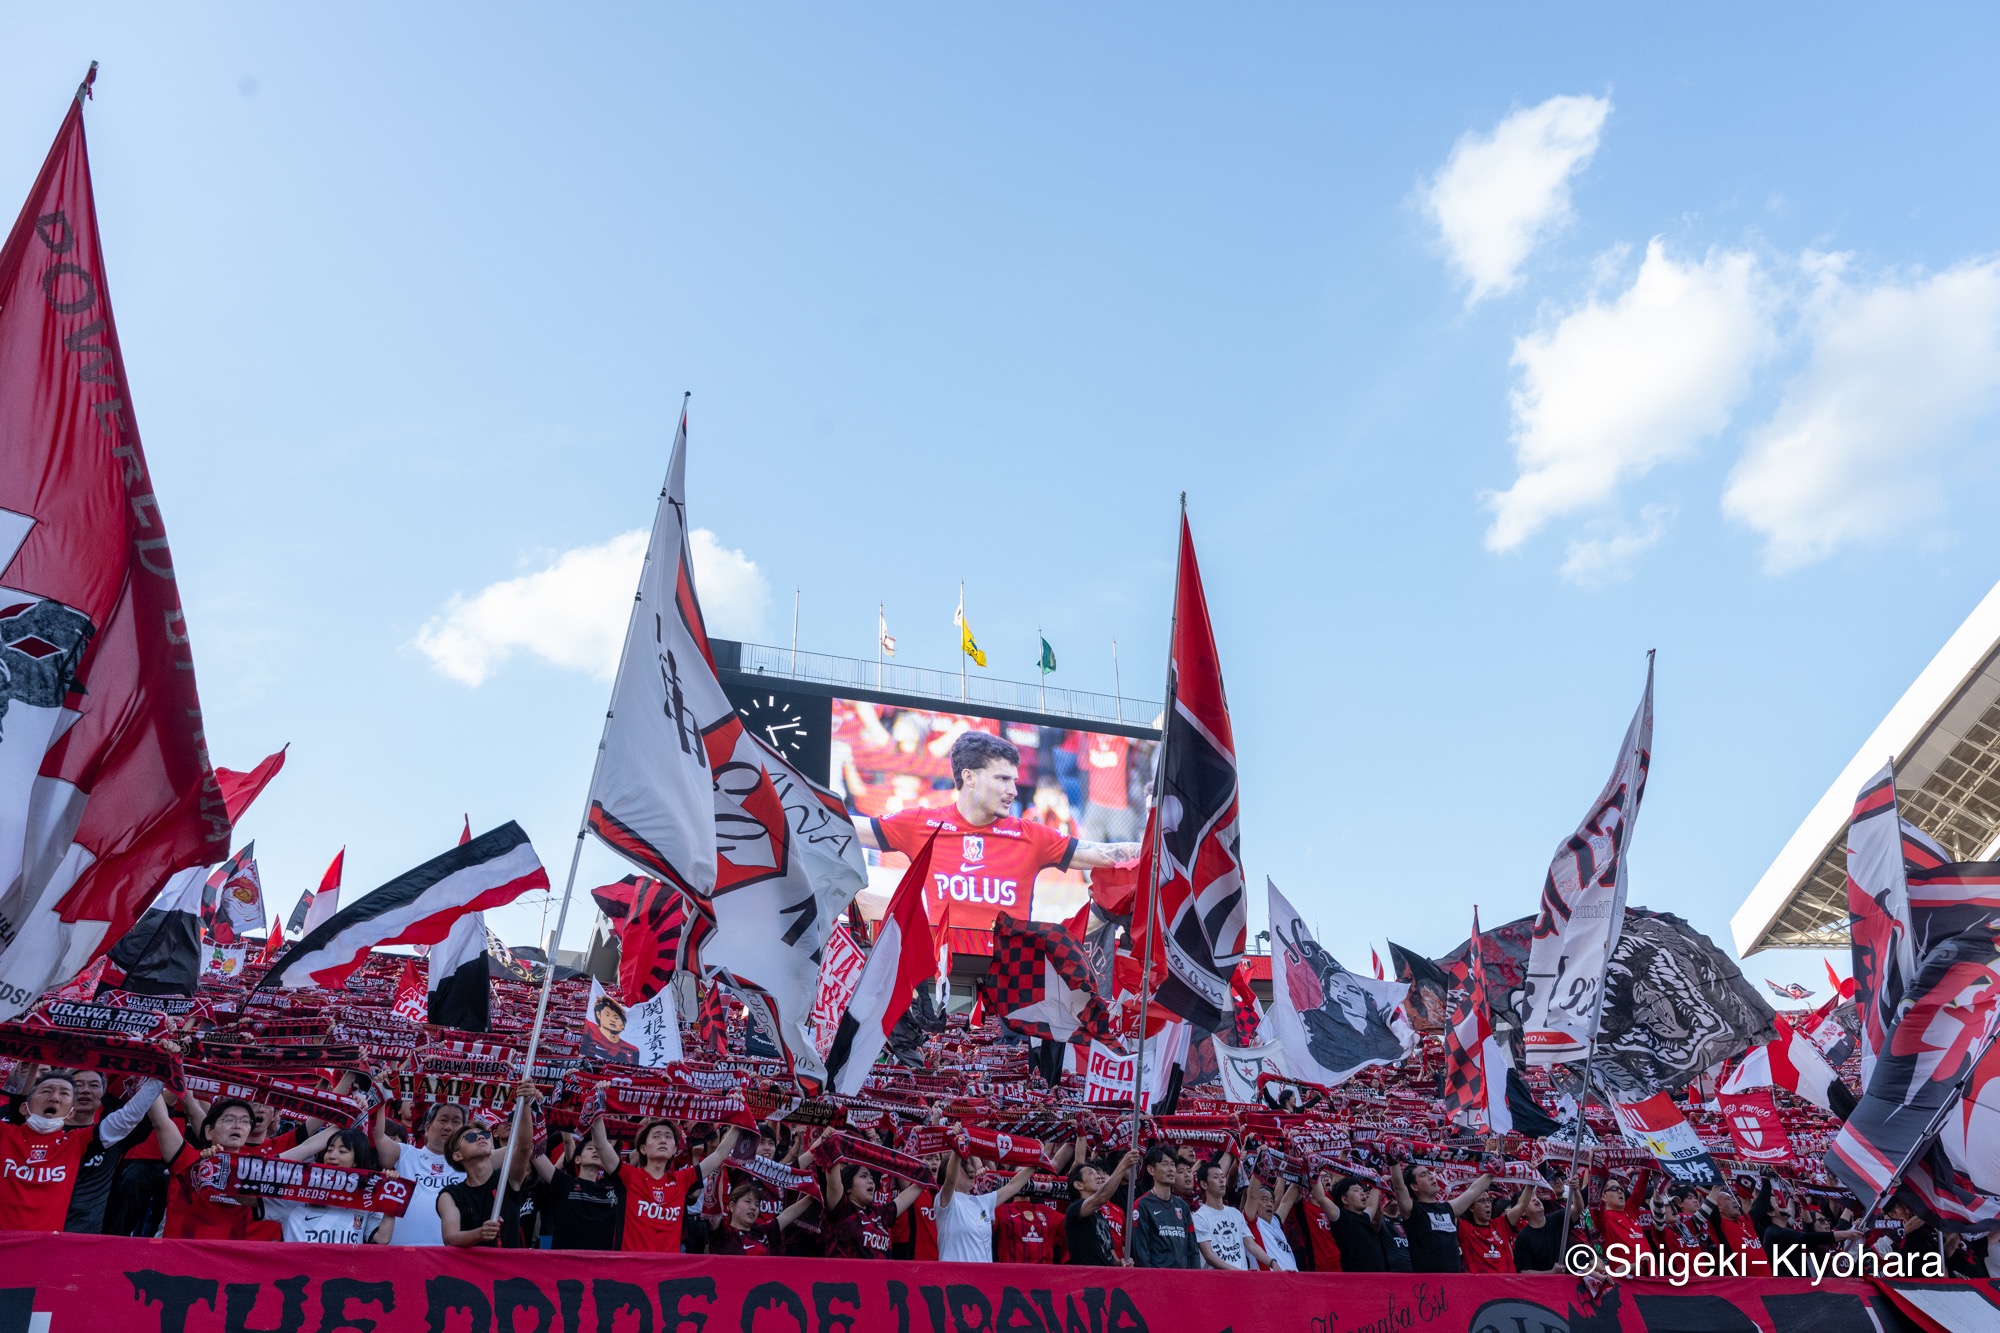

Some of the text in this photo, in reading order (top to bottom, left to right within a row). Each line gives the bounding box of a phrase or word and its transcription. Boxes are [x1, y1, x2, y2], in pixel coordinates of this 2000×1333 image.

[933, 873, 1017, 907] POLUS
[126, 994, 195, 1010] URAWA REDS
[48, 1001, 164, 1029] URAWA REDS
[51, 1014, 151, 1036] PRIDE OF URAWA
[333, 1023, 418, 1041] Here We Go!
[380, 1038, 416, 1048] REDS
[563, 1032, 582, 1043] URAW
[426, 1060, 508, 1074] URAWA REDS
[757, 1063, 783, 1077] RED
[1091, 1051, 1135, 1082] RED
[184, 1075, 255, 1099] RIDE OF
[384, 1074, 517, 1104] CHAMPION
[1005, 1086, 1025, 1100] LIFE
[269, 1092, 349, 1127] URAWA
[797, 1099, 834, 1117] REDS
[1233, 1104, 1264, 1112] URAWA
[1474, 1112, 1484, 1123] A
[1165, 1128, 1226, 1144] CHAMPIONS
[1293, 1133, 1312, 1143] ere
[1311, 1130, 1330, 1142] We
[999, 1140, 1010, 1150] 12
[1322, 1139, 1352, 1150] REDS
[1671, 1146, 1700, 1159] REDS
[236, 1156, 360, 1193] URAWA REDS
[1445, 1162, 1477, 1173] DIAMONDS
[415, 1173, 459, 1189] POLUS
[259, 1183, 330, 1200] We are REDS!
[362, 1173, 382, 1208] URAWA
[379, 1181, 408, 1204] 13
[637, 1199, 682, 1222] POLUS
[759, 1199, 785, 1215] OLUS
[862, 1231, 891, 1251] POLUS
[1158, 1229, 1186, 1239] MIRAGE
[1311, 1282, 1448, 1333] Kmaba Est
